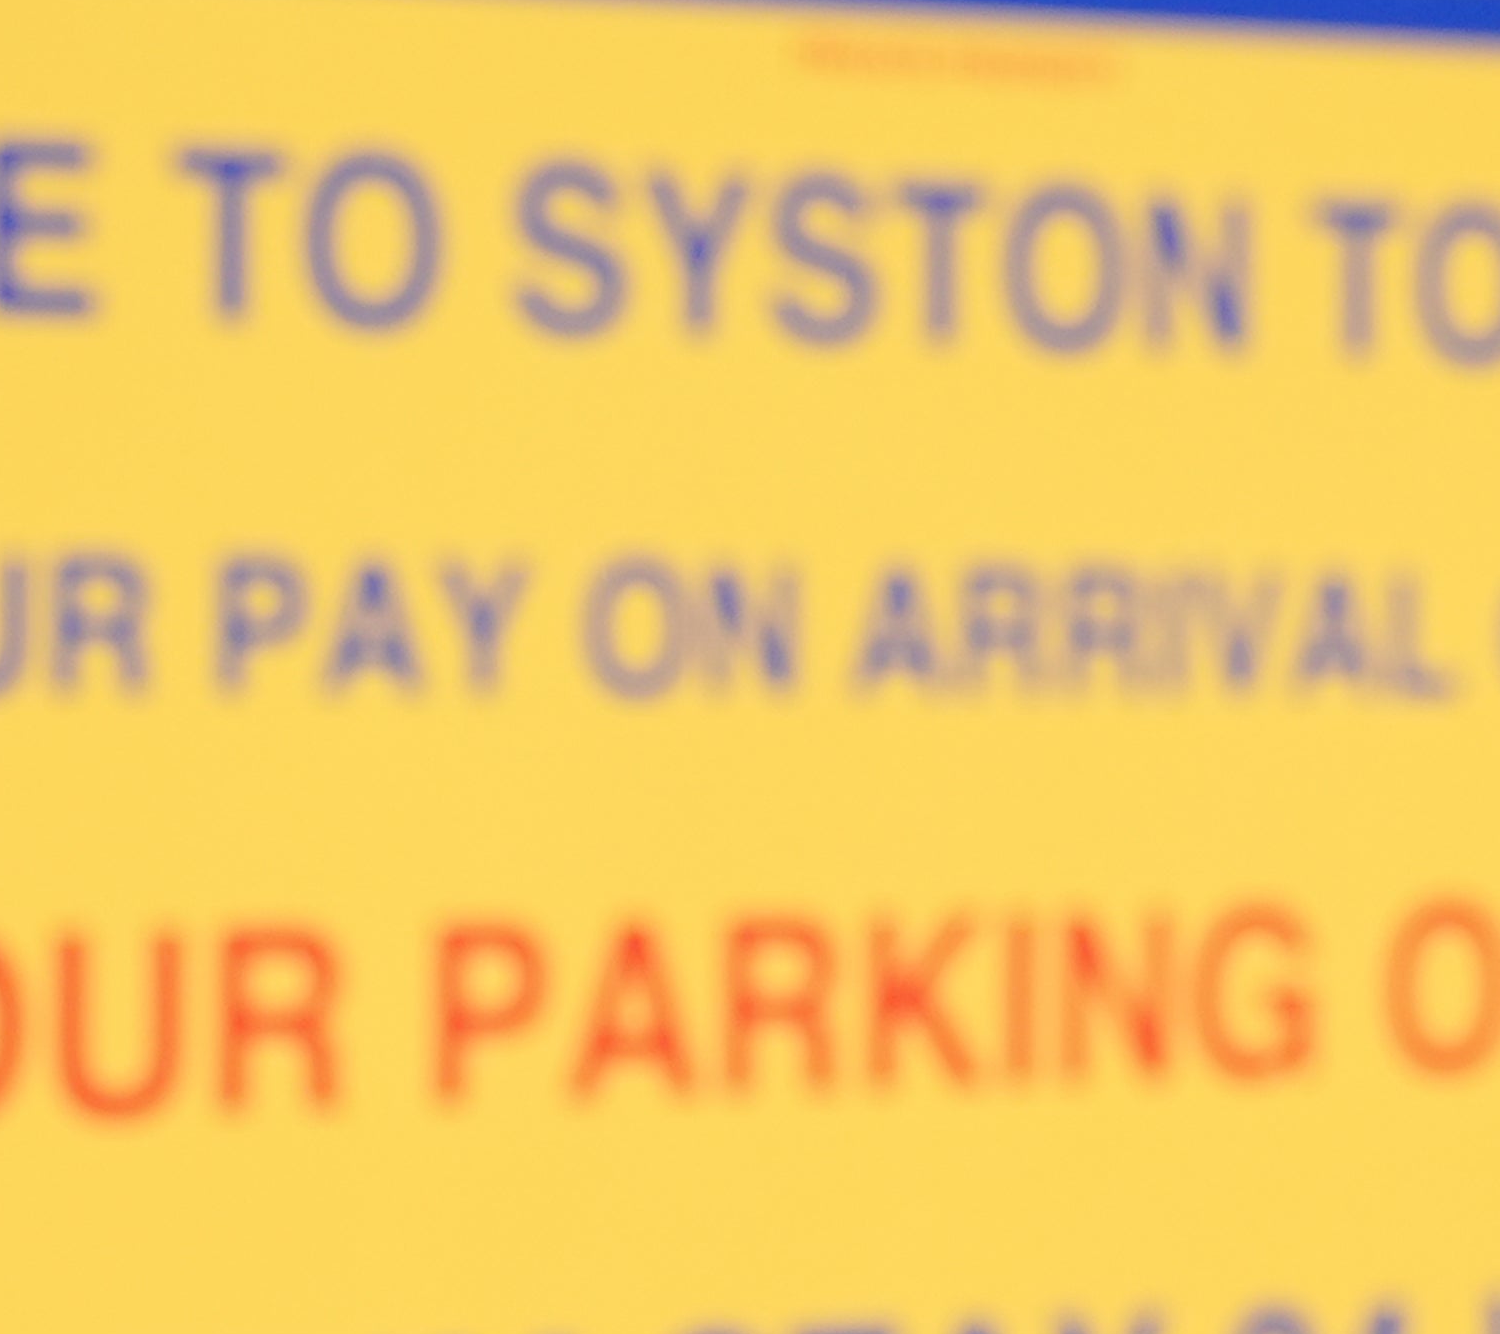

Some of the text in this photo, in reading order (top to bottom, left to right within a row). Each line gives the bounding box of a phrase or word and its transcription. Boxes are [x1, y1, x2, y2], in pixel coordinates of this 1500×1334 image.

[171, 140, 448, 337] TO
[510, 154, 1255, 359] SYSTON
[212, 550, 529, 692] PAY
[579, 551, 803, 705] ON
[851, 559, 1453, 703] ARRIVAL
[430, 899, 1319, 1106] PARKING
